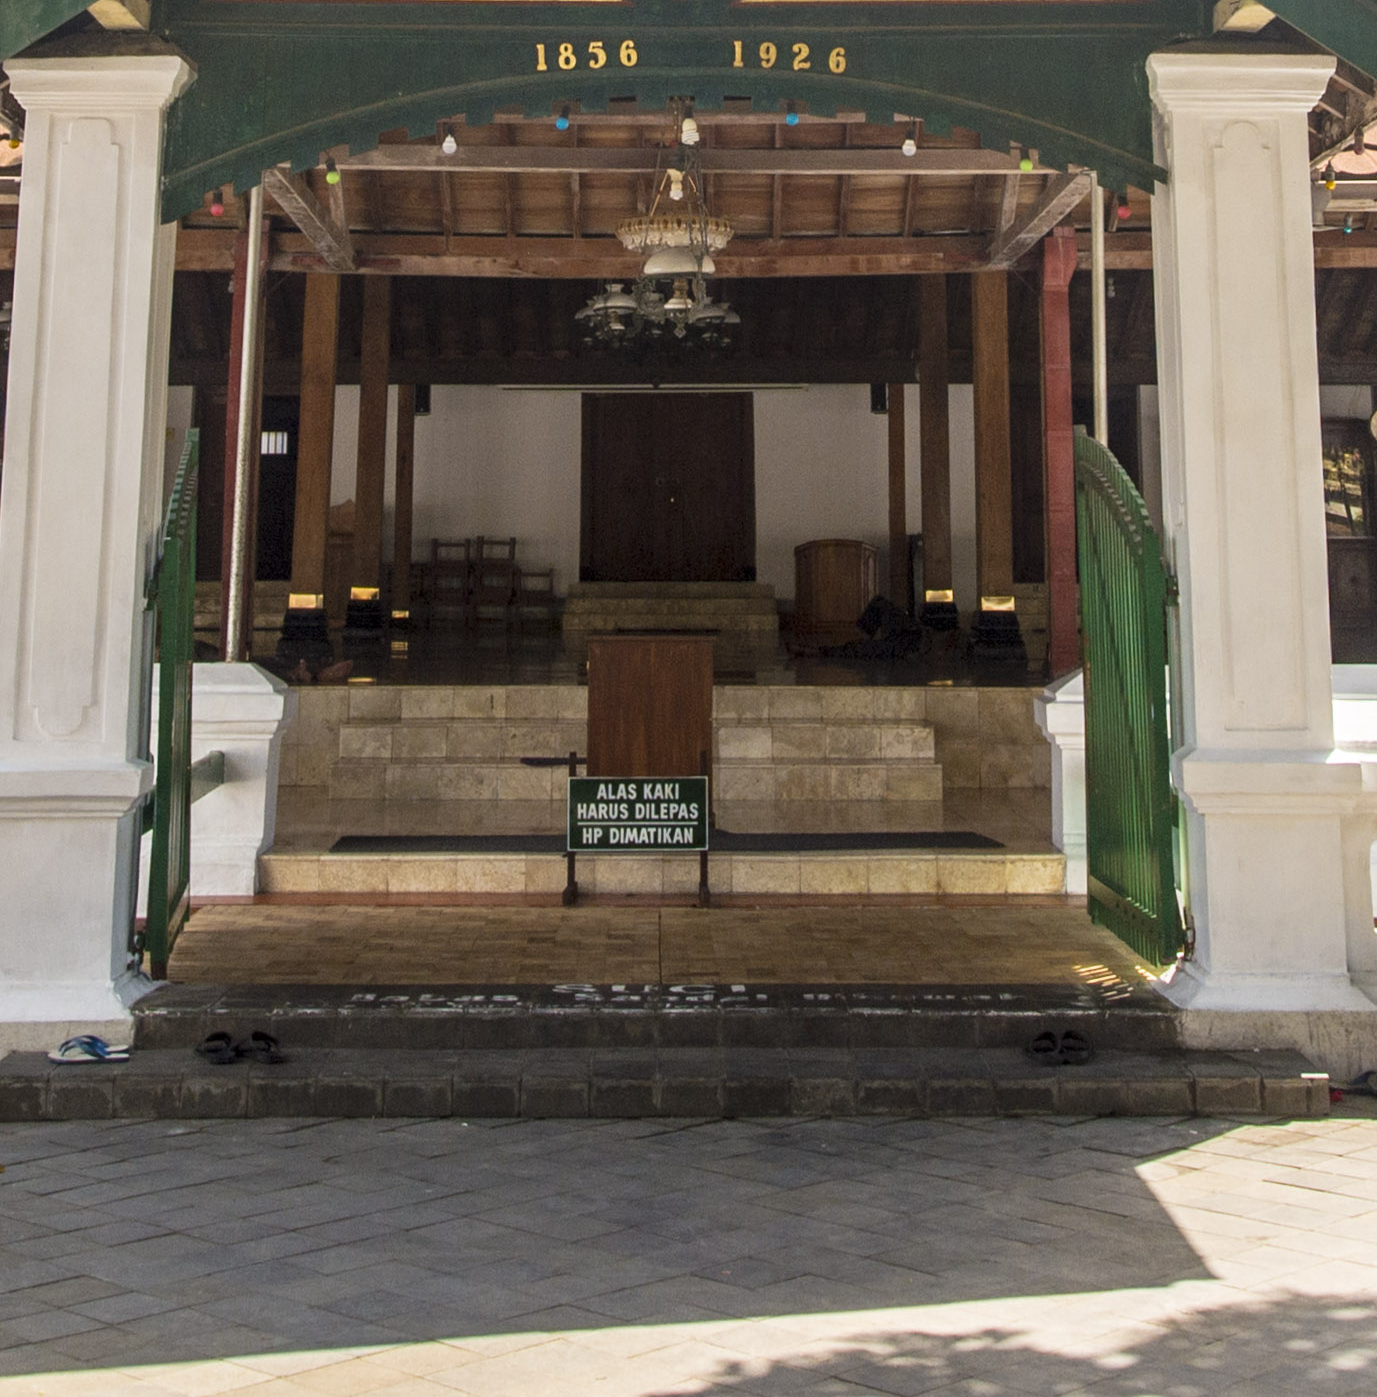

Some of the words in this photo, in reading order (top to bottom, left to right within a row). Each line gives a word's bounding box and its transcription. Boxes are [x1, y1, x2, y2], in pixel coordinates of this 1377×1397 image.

[536, 40, 638, 71] 1856
[733, 40, 847, 74] 1926
[597, 783, 637, 800] ALAS
[643, 783, 679, 800] KAKI
[577, 803, 629, 820] HARUS
[635, 803, 699, 819] DILEPAS
[582, 827, 603, 844] HP
[609, 827, 694, 844] DIMATIKAN
